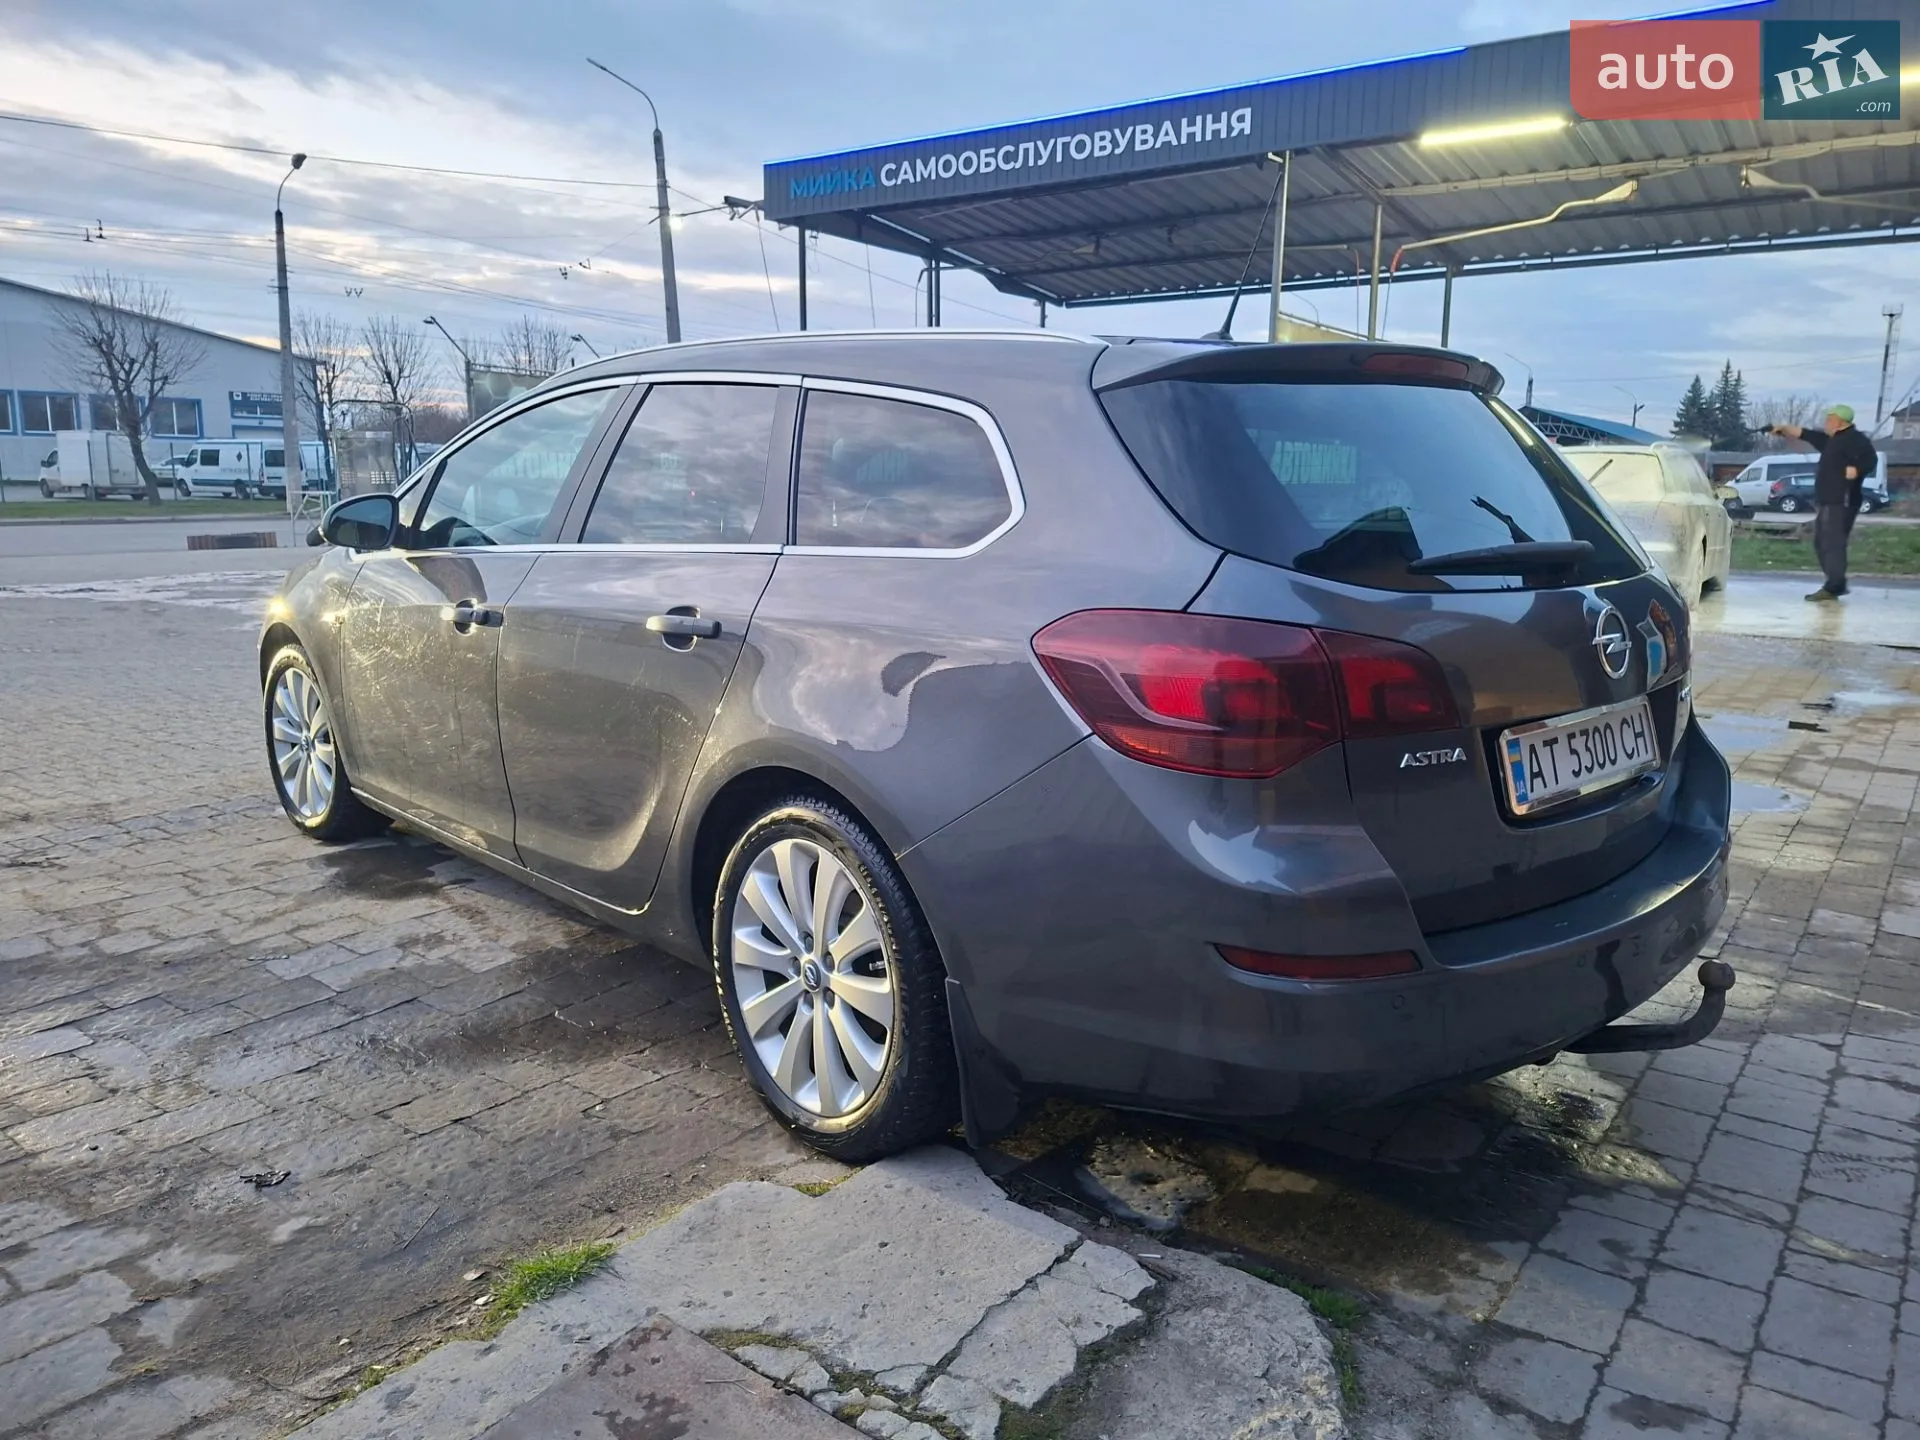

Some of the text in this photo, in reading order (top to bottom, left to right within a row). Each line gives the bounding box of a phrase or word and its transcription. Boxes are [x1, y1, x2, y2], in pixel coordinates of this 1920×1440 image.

[790, 107, 1252, 199] МИЙКА САМООБСЛУГОВУВАННЯ
[1400, 747, 1468, 768] ASTRA
[1529, 737, 1559, 794] AT
[1567, 722, 1618, 778] 5300
[1620, 712, 1649, 760] CH
